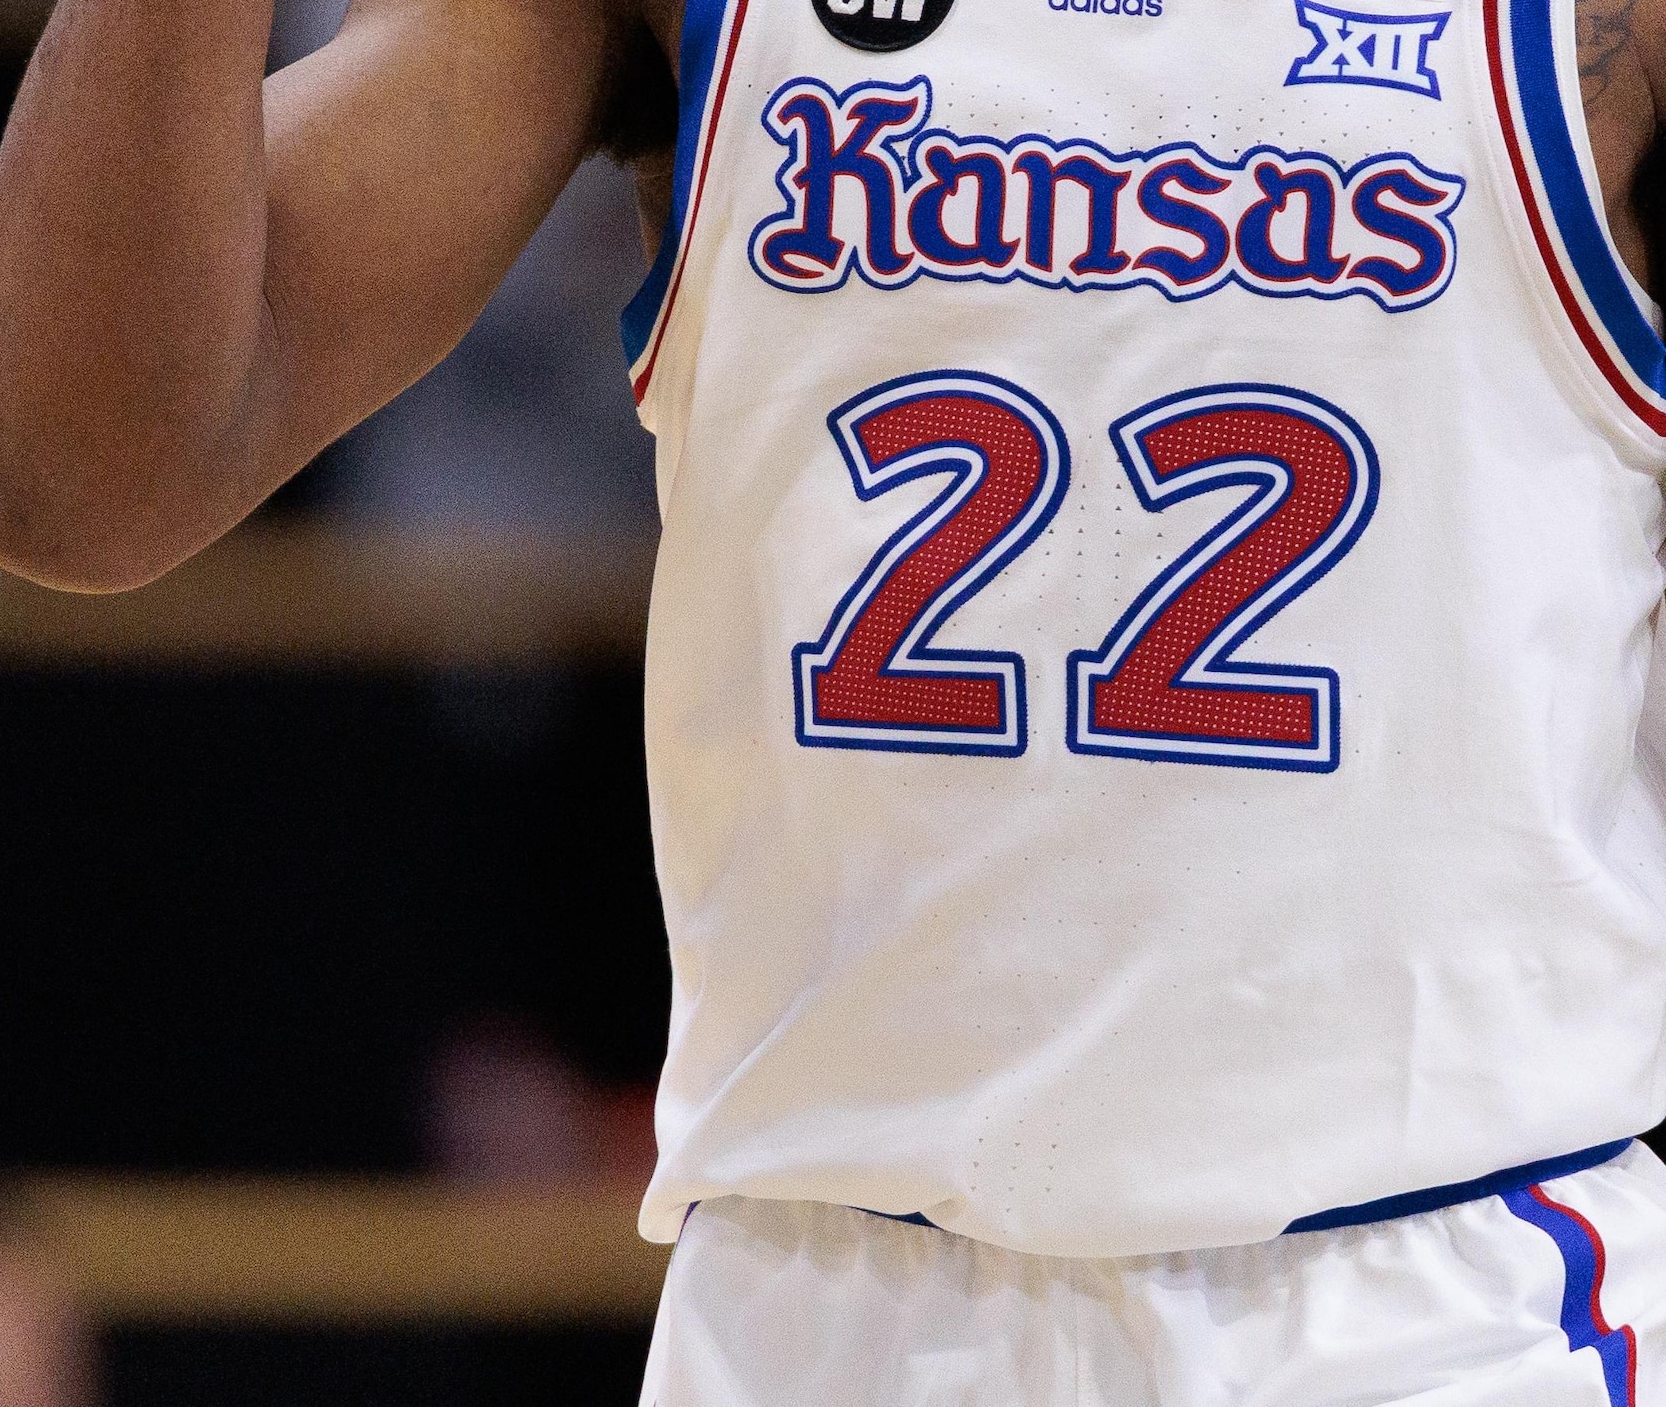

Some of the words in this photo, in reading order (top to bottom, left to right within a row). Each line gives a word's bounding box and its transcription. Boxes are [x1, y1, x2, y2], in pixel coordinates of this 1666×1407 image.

[1295, 10, 1437, 90] XII
[748, 74, 1466, 313] Kansas
[791, 368, 1381, 773] 22
